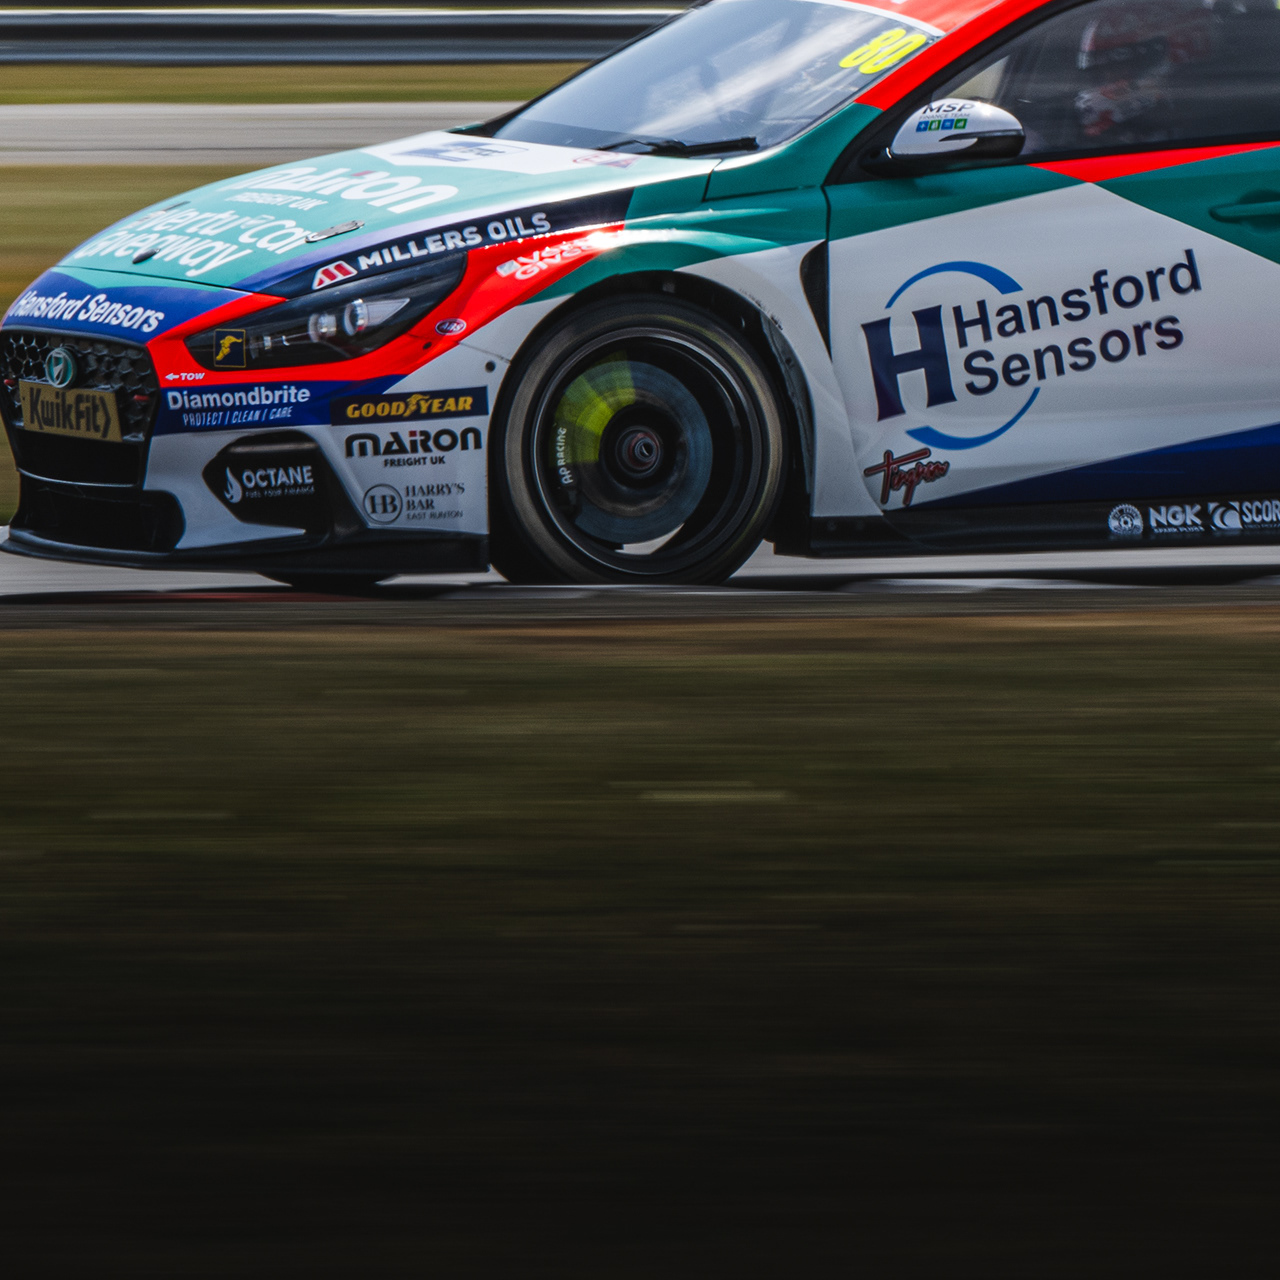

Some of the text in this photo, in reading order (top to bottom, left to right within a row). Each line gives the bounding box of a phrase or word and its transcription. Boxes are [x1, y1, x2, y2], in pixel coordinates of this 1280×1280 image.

[839, 28, 927, 74] 80
[922, 102, 975, 114] MSP
[357, 226, 483, 271] MILLERS
[487, 212, 551, 240] OILS
[952, 248, 1202, 349] Hansford
[9, 290, 165, 332] Hansford Sensors
[860, 304, 958, 422] H
[963, 315, 1185, 397] Sensors
[180, 373, 205, 381] TOW
[167, 385, 311, 411] Diamondbrite
[183, 406, 294, 427] PROTECT CLEAN CARE
[383, 455, 445, 467] FREIGHT UK
[242, 465, 314, 489] OCTANE
[404, 483, 465, 498] HARRY'S
[406, 499, 435, 511] BAR
[406, 512, 427, 520] EAST
[1149, 504, 1203, 527] NGK
